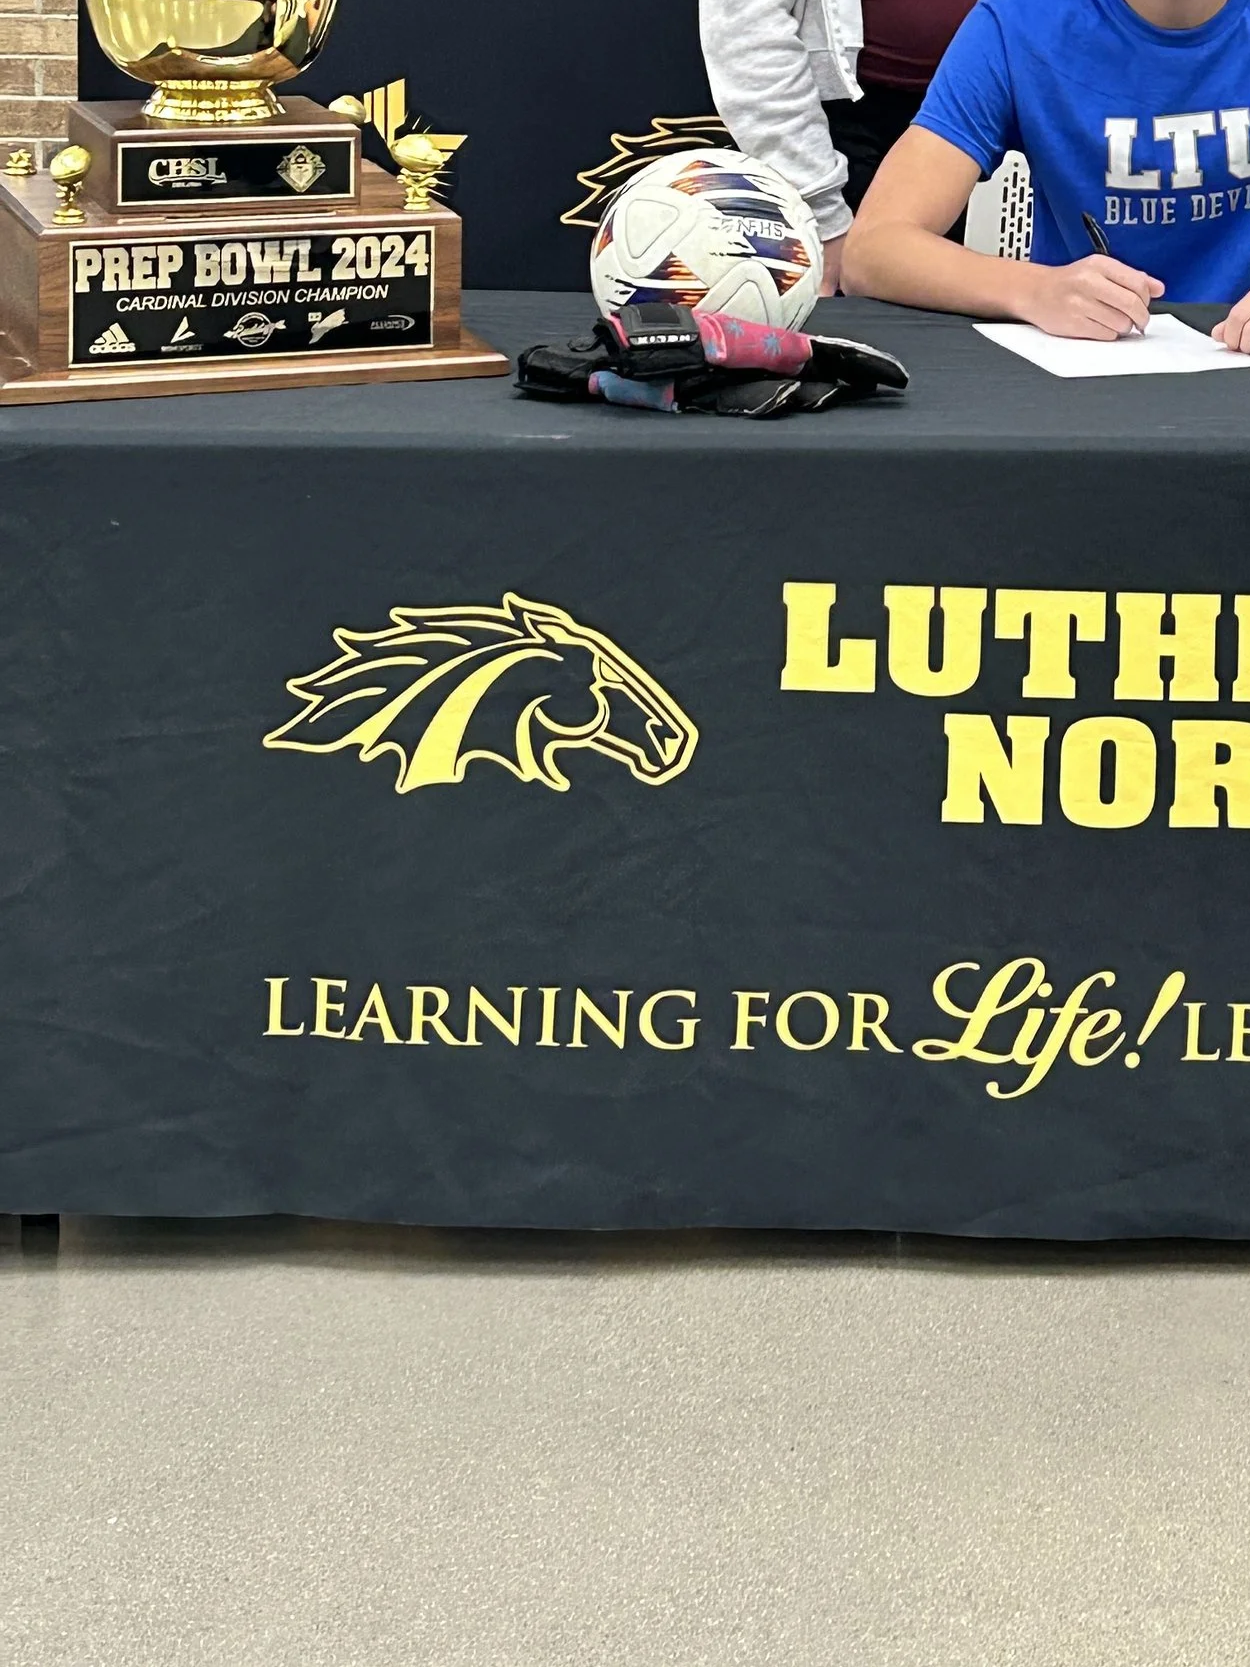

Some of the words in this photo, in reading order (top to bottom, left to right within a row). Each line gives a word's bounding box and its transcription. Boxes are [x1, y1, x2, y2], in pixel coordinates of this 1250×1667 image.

[148, 157, 228, 184] CHSL
[1104, 196, 1176, 225] BLUE
[736, 219, 785, 238] NFHS
[75, 244, 184, 293] PREP
[194, 239, 322, 288] BOWL
[331, 234, 430, 281] 2024
[116, 291, 208, 313] CARDINAL
[211, 288, 289, 308] DIVISION
[294, 284, 389, 305] CHAMPION
[264, 976, 700, 1051] LEARNING
[731, 990, 904, 1053] FOR
[911, 957, 1186, 1100] Life!
